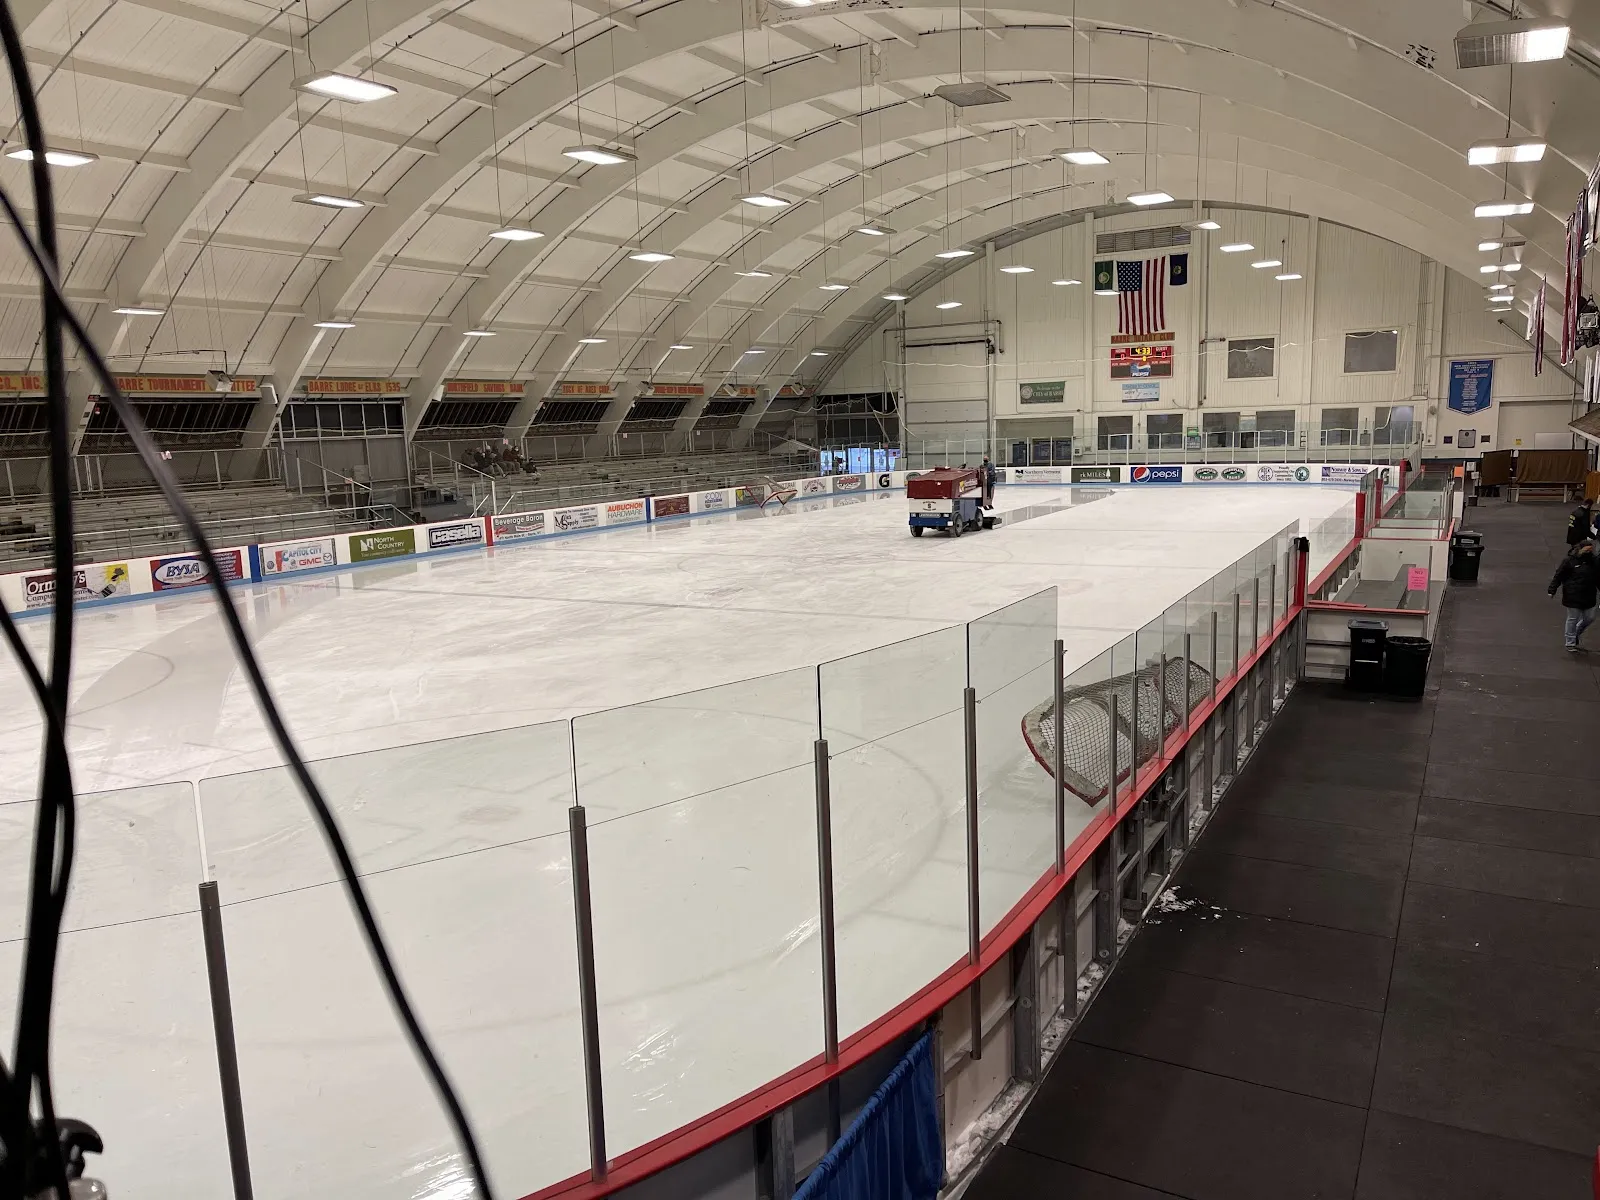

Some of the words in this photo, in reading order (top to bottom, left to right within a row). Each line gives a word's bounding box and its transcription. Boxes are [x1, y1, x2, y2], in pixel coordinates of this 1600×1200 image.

[148, 379, 206, 391] TOURNAMENT
[309, 382, 333, 392] BARRE
[337, 382, 357, 392] LODGE
[1152, 468, 1179, 479] pepsi
[608, 502, 643, 512] AUBUCHON
[608, 509, 643, 518] HARDWARE
[495, 517, 525, 526] Beverage
[525, 515, 543, 523] Baron
[432, 523, 481, 543] casella
[374, 536, 394, 544] NORTH
[377, 541, 404, 550] COUNTRY
[299, 557, 322, 566] GMC
[166, 562, 200, 577] BYSA
